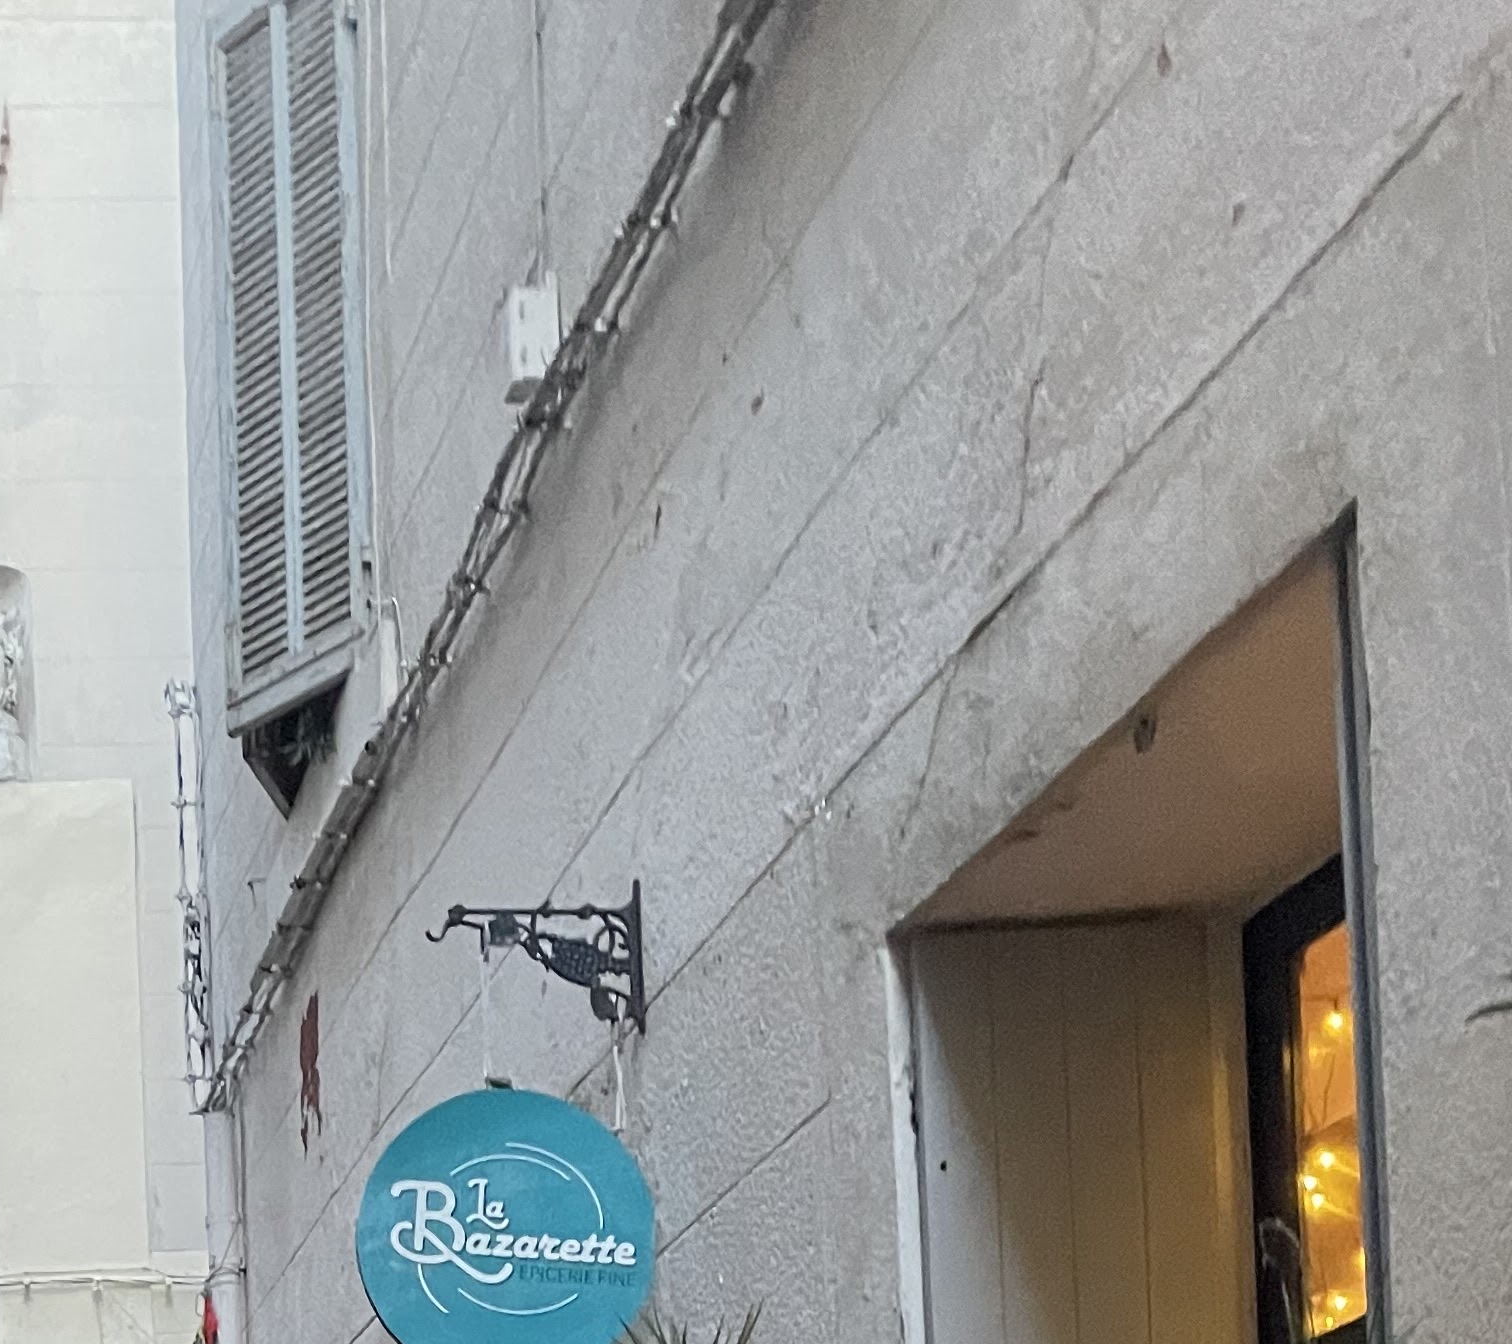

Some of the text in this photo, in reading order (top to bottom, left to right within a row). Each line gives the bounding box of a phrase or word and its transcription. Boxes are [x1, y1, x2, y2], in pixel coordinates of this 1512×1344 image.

[466, 1178, 510, 1229] La
[390, 1179, 637, 1284] Bazarette
[597, 1268, 636, 1287] FINE
